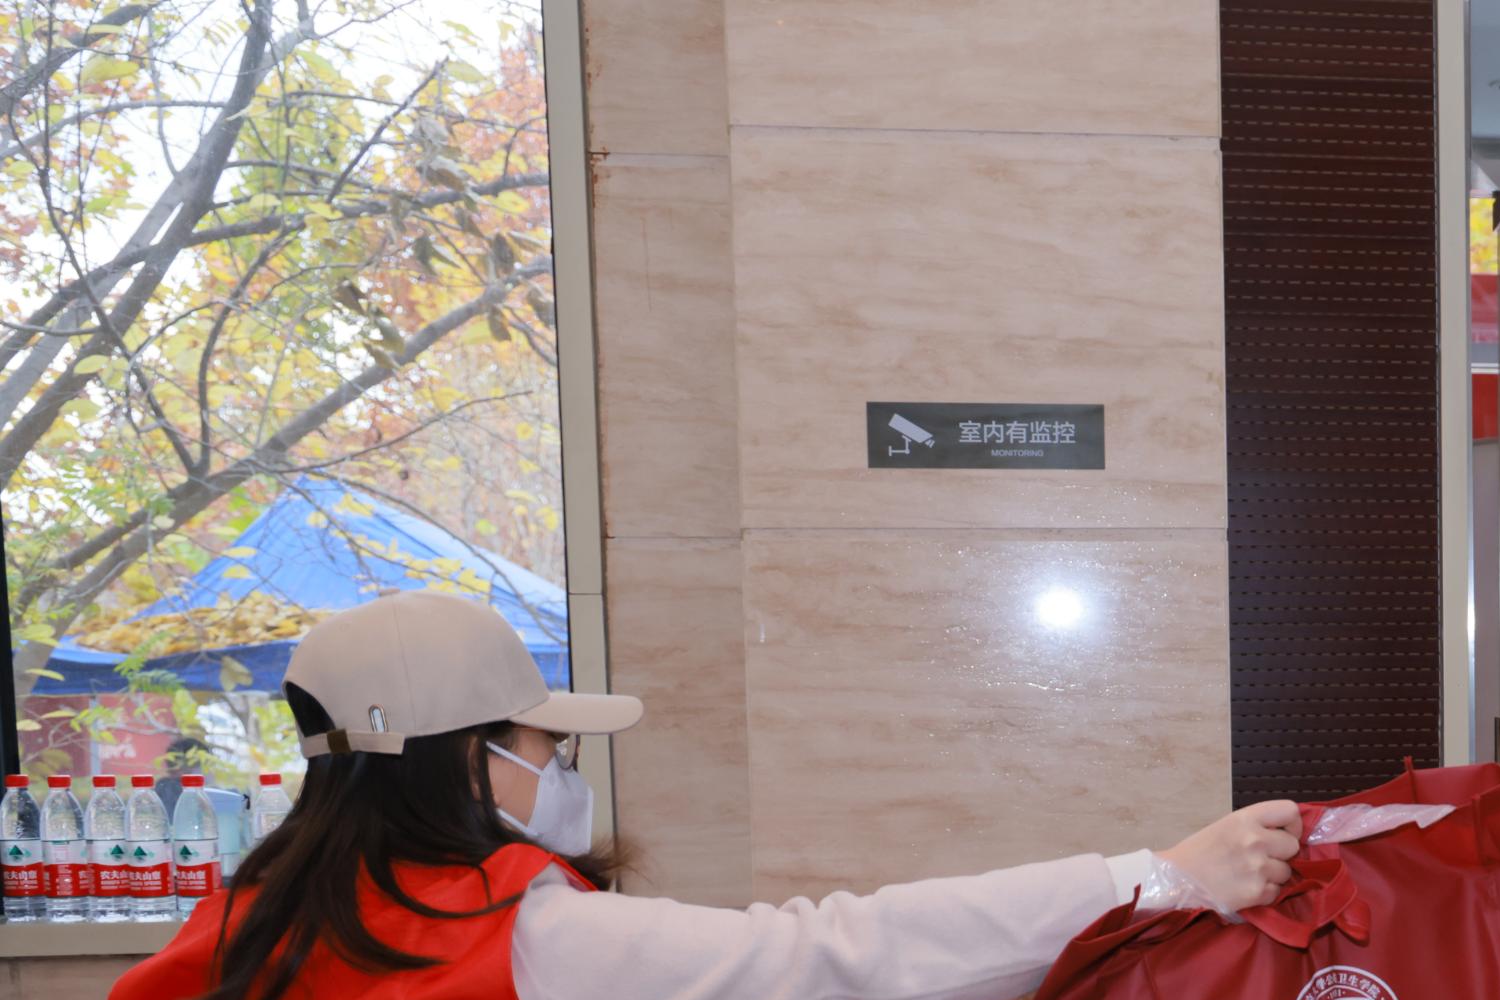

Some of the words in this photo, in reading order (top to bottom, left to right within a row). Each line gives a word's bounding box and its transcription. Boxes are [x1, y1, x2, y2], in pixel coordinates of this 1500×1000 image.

[958, 420, 1076, 444] 室内有监控
[990, 449, 1044, 457] MONITORING
